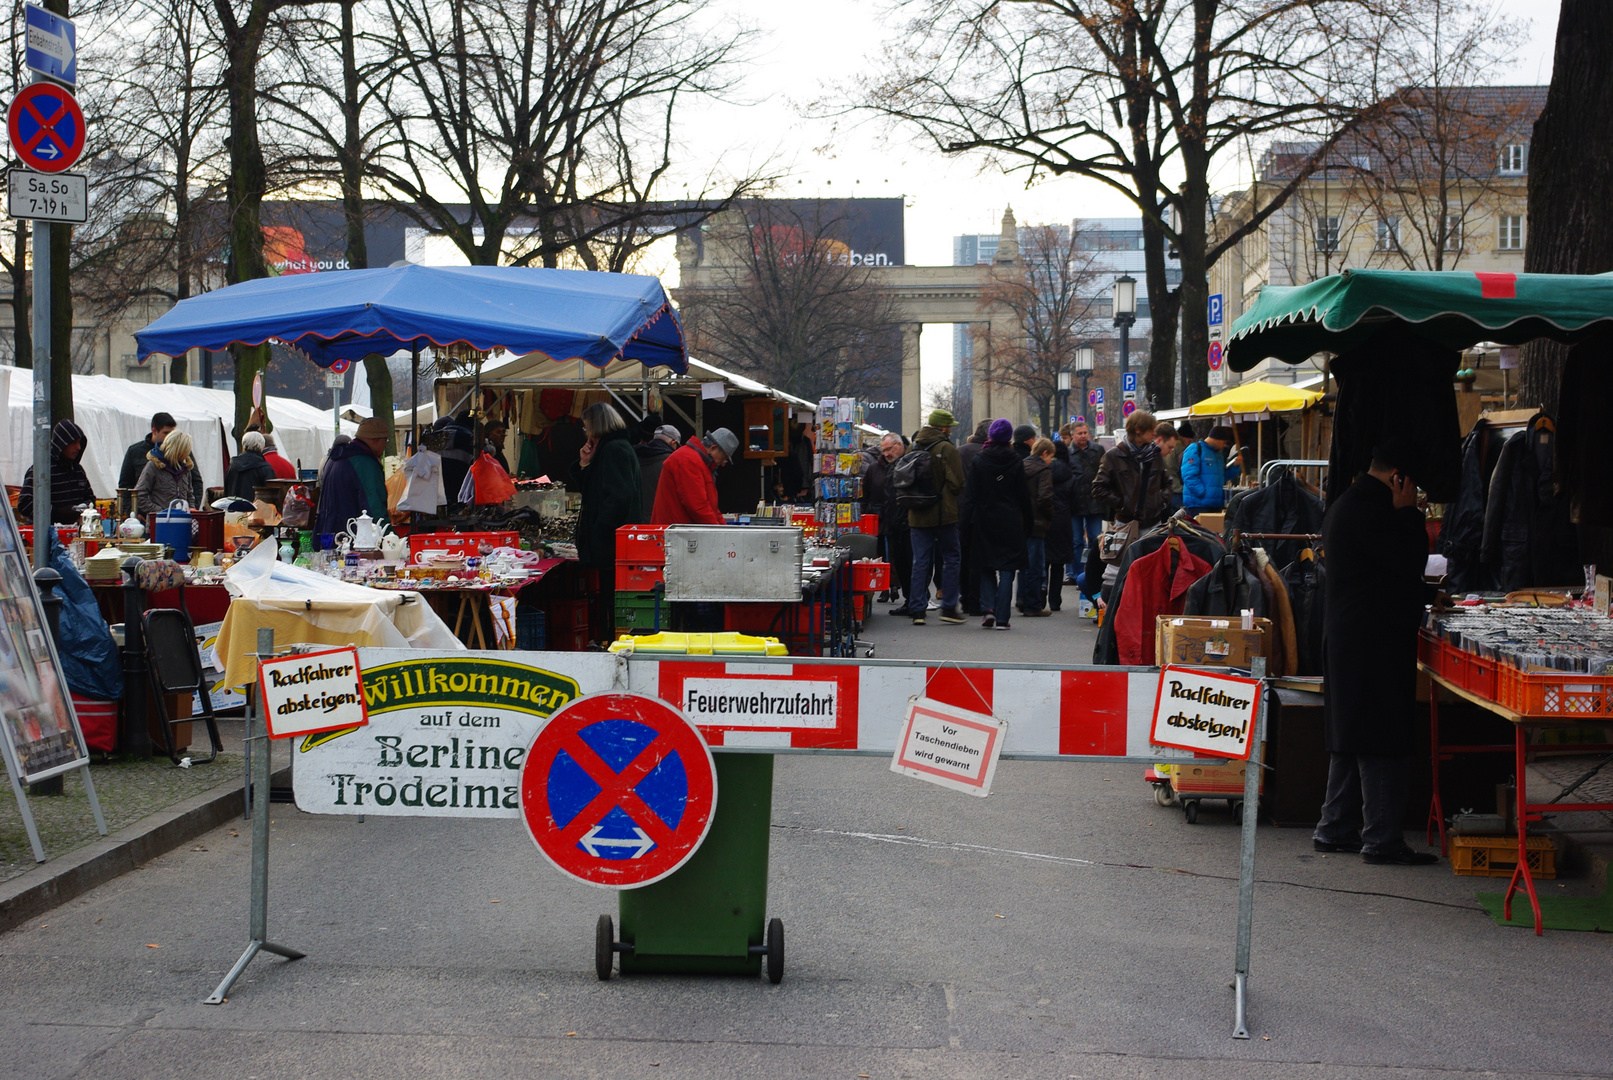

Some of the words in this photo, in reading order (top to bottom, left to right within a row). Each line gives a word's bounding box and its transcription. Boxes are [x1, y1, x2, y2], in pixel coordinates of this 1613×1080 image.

[30, 199, 56, 214] 7-19
[61, 203, 67, 215] h
[274, 259, 306, 270] what
[310, 259, 333, 272] you
[1211, 298, 1219, 321] P
[727, 551, 736, 559] 10
[268, 663, 354, 688] Radfahrer
[277, 682, 362, 716] absteigen!
[362, 667, 570, 710] Willkommen
[1169, 680, 1250, 710] Radfahrer
[688, 690, 834, 716] Feuerwehrzufahrt
[420, 711, 453, 727] auf
[458, 711, 501, 728] dem
[942, 724, 958, 736] Vor
[1167, 711, 1248, 744] absteigen!
[914, 731, 980, 757] Taschendieben
[914, 749, 933, 762] wird
[934, 755, 970, 771] gewarnt
